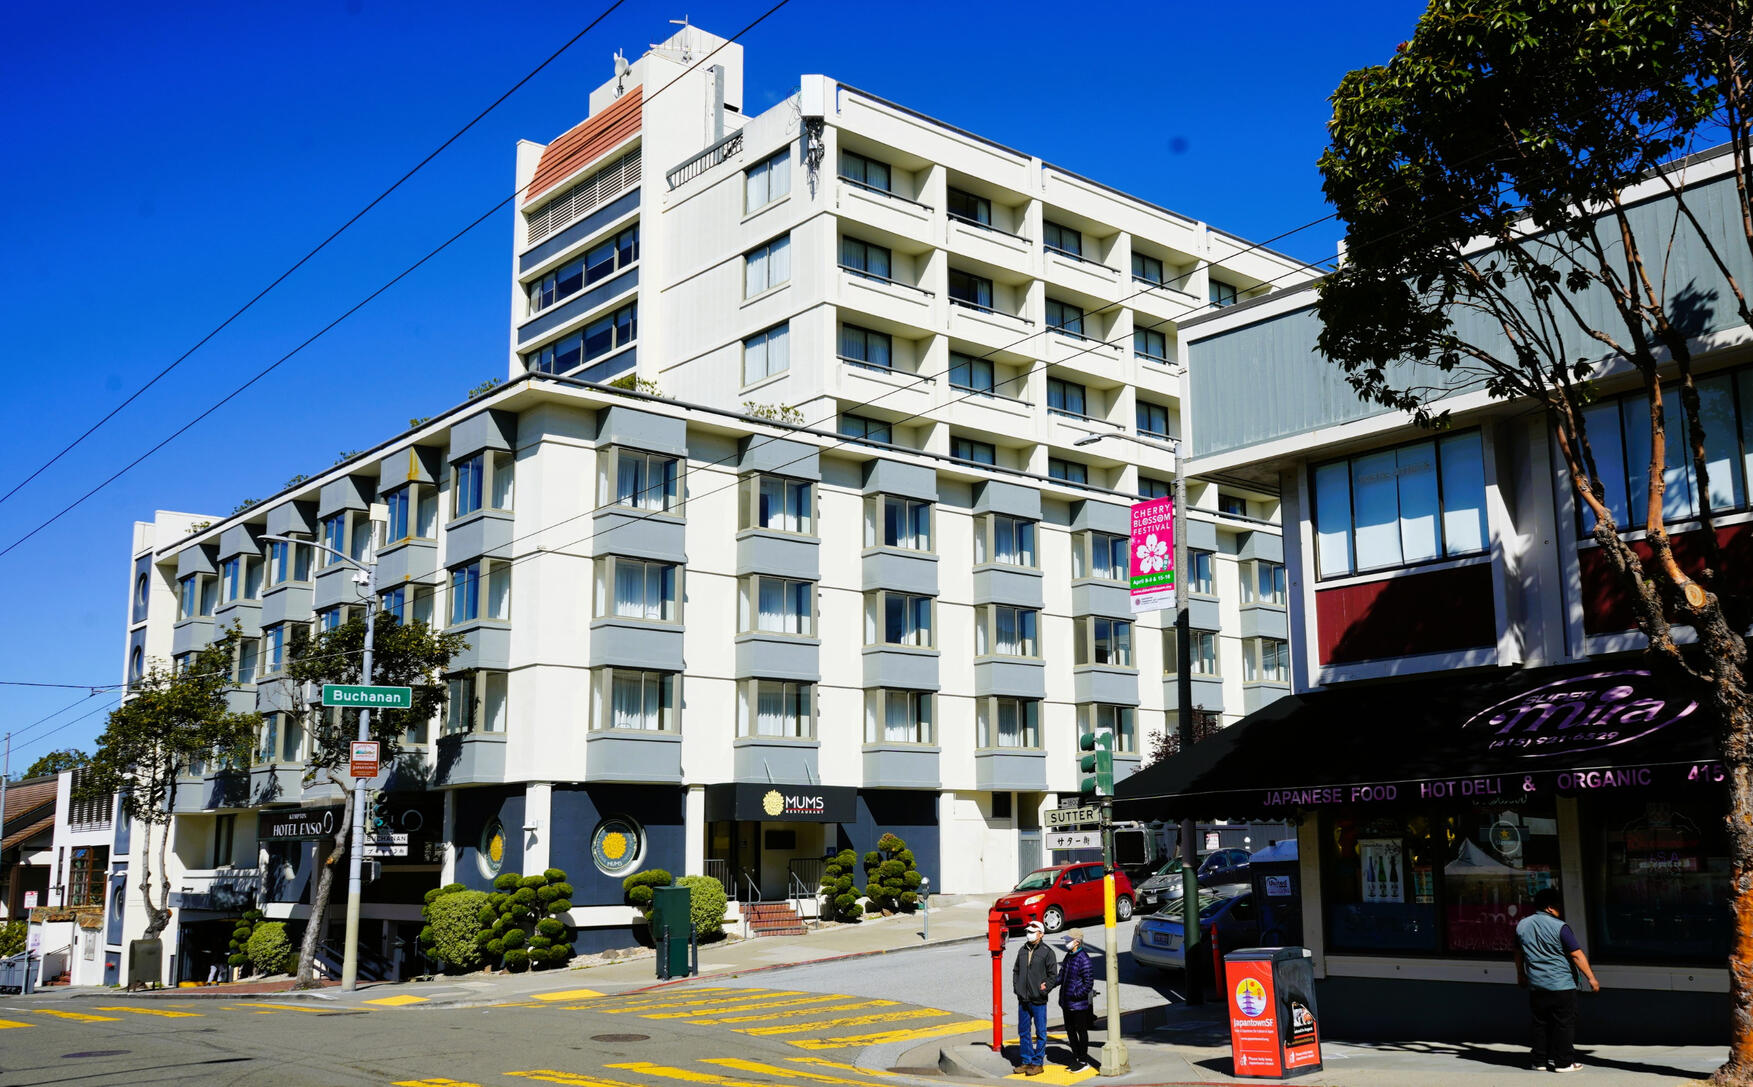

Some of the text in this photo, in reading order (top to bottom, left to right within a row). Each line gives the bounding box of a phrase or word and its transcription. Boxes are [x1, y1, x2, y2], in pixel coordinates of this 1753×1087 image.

[1134, 504, 1170, 518] CHERRY
[1133, 513, 1170, 528] BLOSSOM
[1133, 523, 1171, 536] FESTIVAL
[1133, 578, 1145, 586] April
[333, 690, 401, 703] Buchanan
[1521, 690, 1597, 705] SUPER
[1489, 737, 1532, 750] (415)
[1263, 764, 1725, 806] JAPANESE FOOD HOT DELI & ORGANIC 415
[785, 795, 824, 809] MUMS
[1050, 809, 1094, 823] SUTTER
[273, 822, 322, 837] HOTEL ENSO
[1233, 1018, 1273, 1028] JapantownSF
